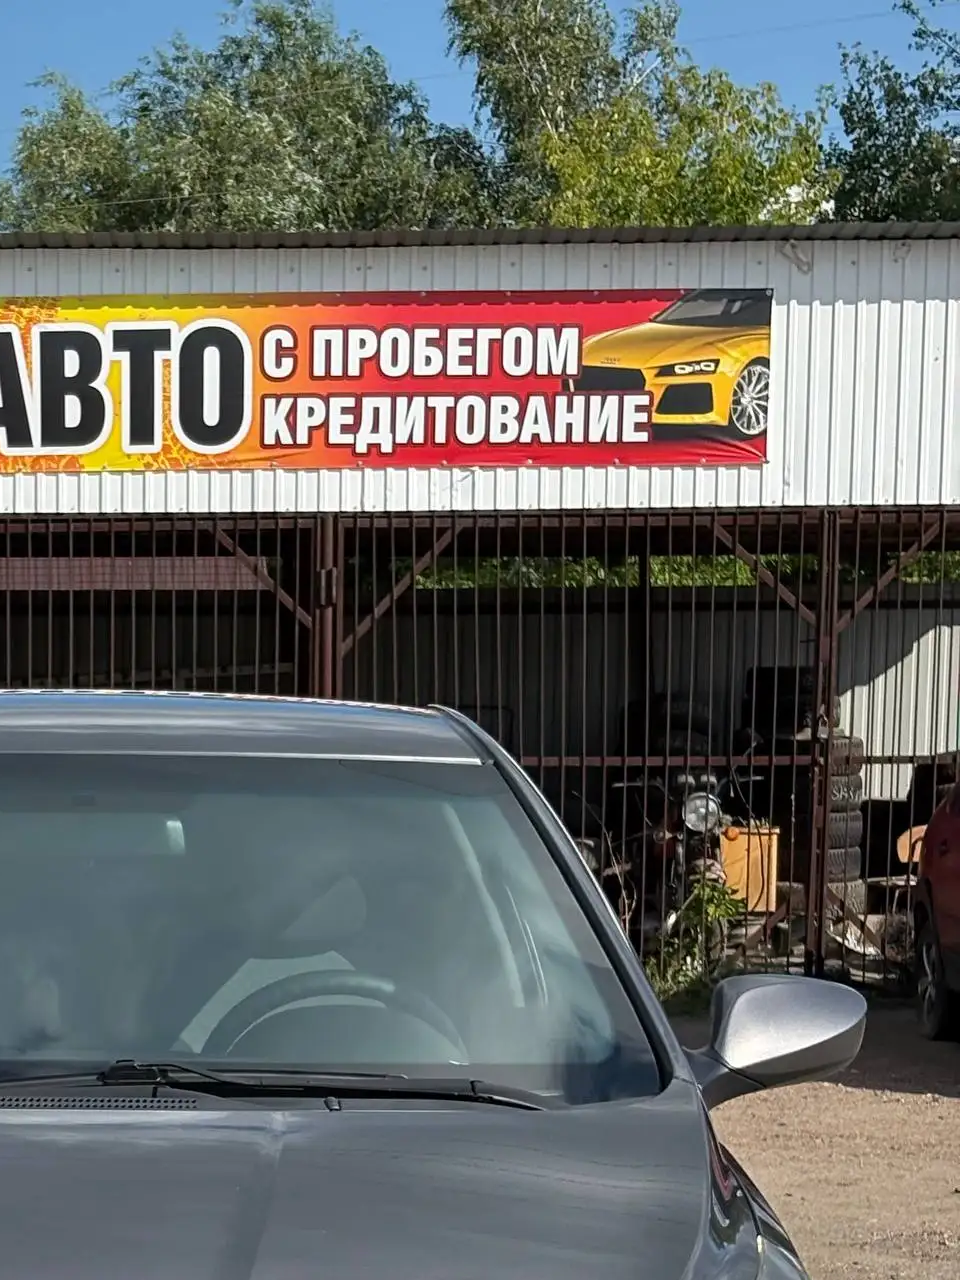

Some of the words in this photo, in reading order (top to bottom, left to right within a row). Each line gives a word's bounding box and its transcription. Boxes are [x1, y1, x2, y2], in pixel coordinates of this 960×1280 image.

[263, 328, 295, 378] С
[312, 327, 579, 377] ПРОБЕГОМ
[262, 394, 651, 454] КРЕДИТОВАНИЕ
